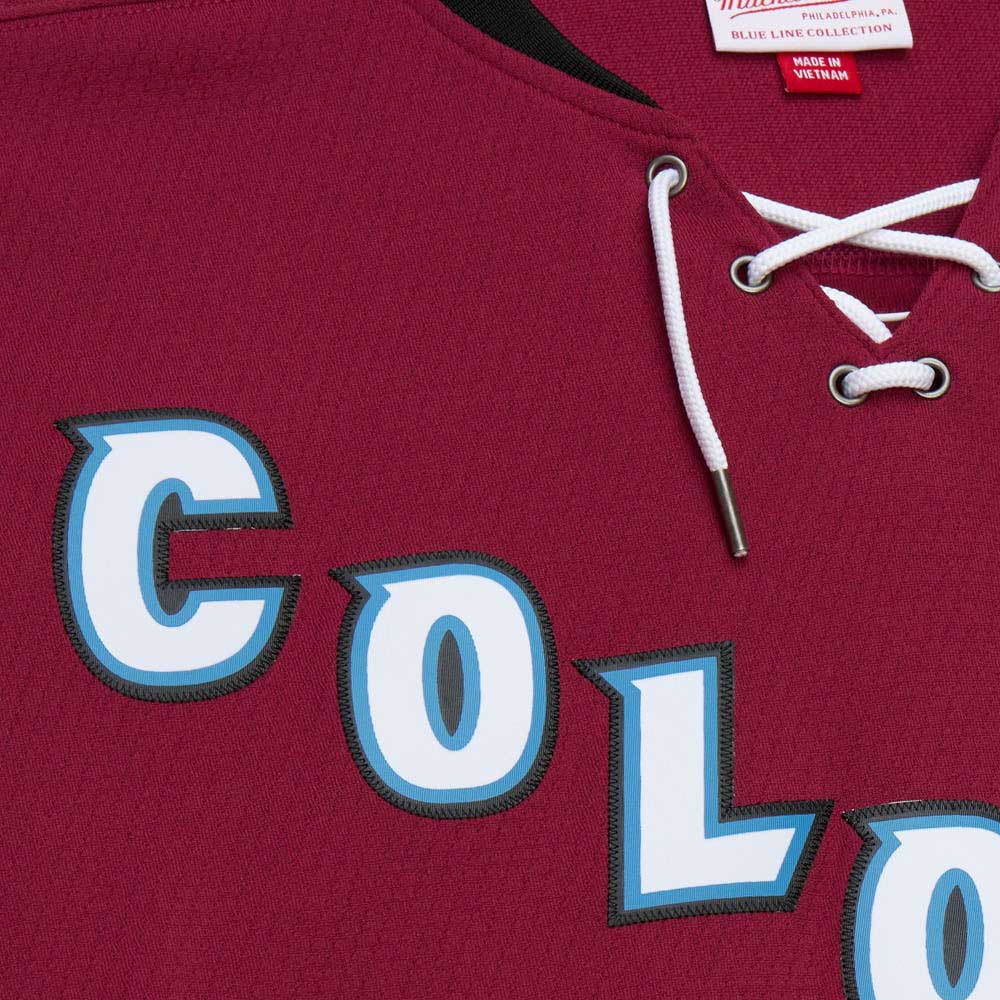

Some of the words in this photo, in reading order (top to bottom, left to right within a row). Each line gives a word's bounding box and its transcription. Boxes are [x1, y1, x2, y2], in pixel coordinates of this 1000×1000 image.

[731, 30, 767, 40] BLUE
[770, 28, 804, 39] LINE
[807, 23, 893, 38] COLLECTION
[792, 56, 826, 68] MADE
[828, 57, 841, 68] IN
[793, 69, 849, 81] VIETNAM
